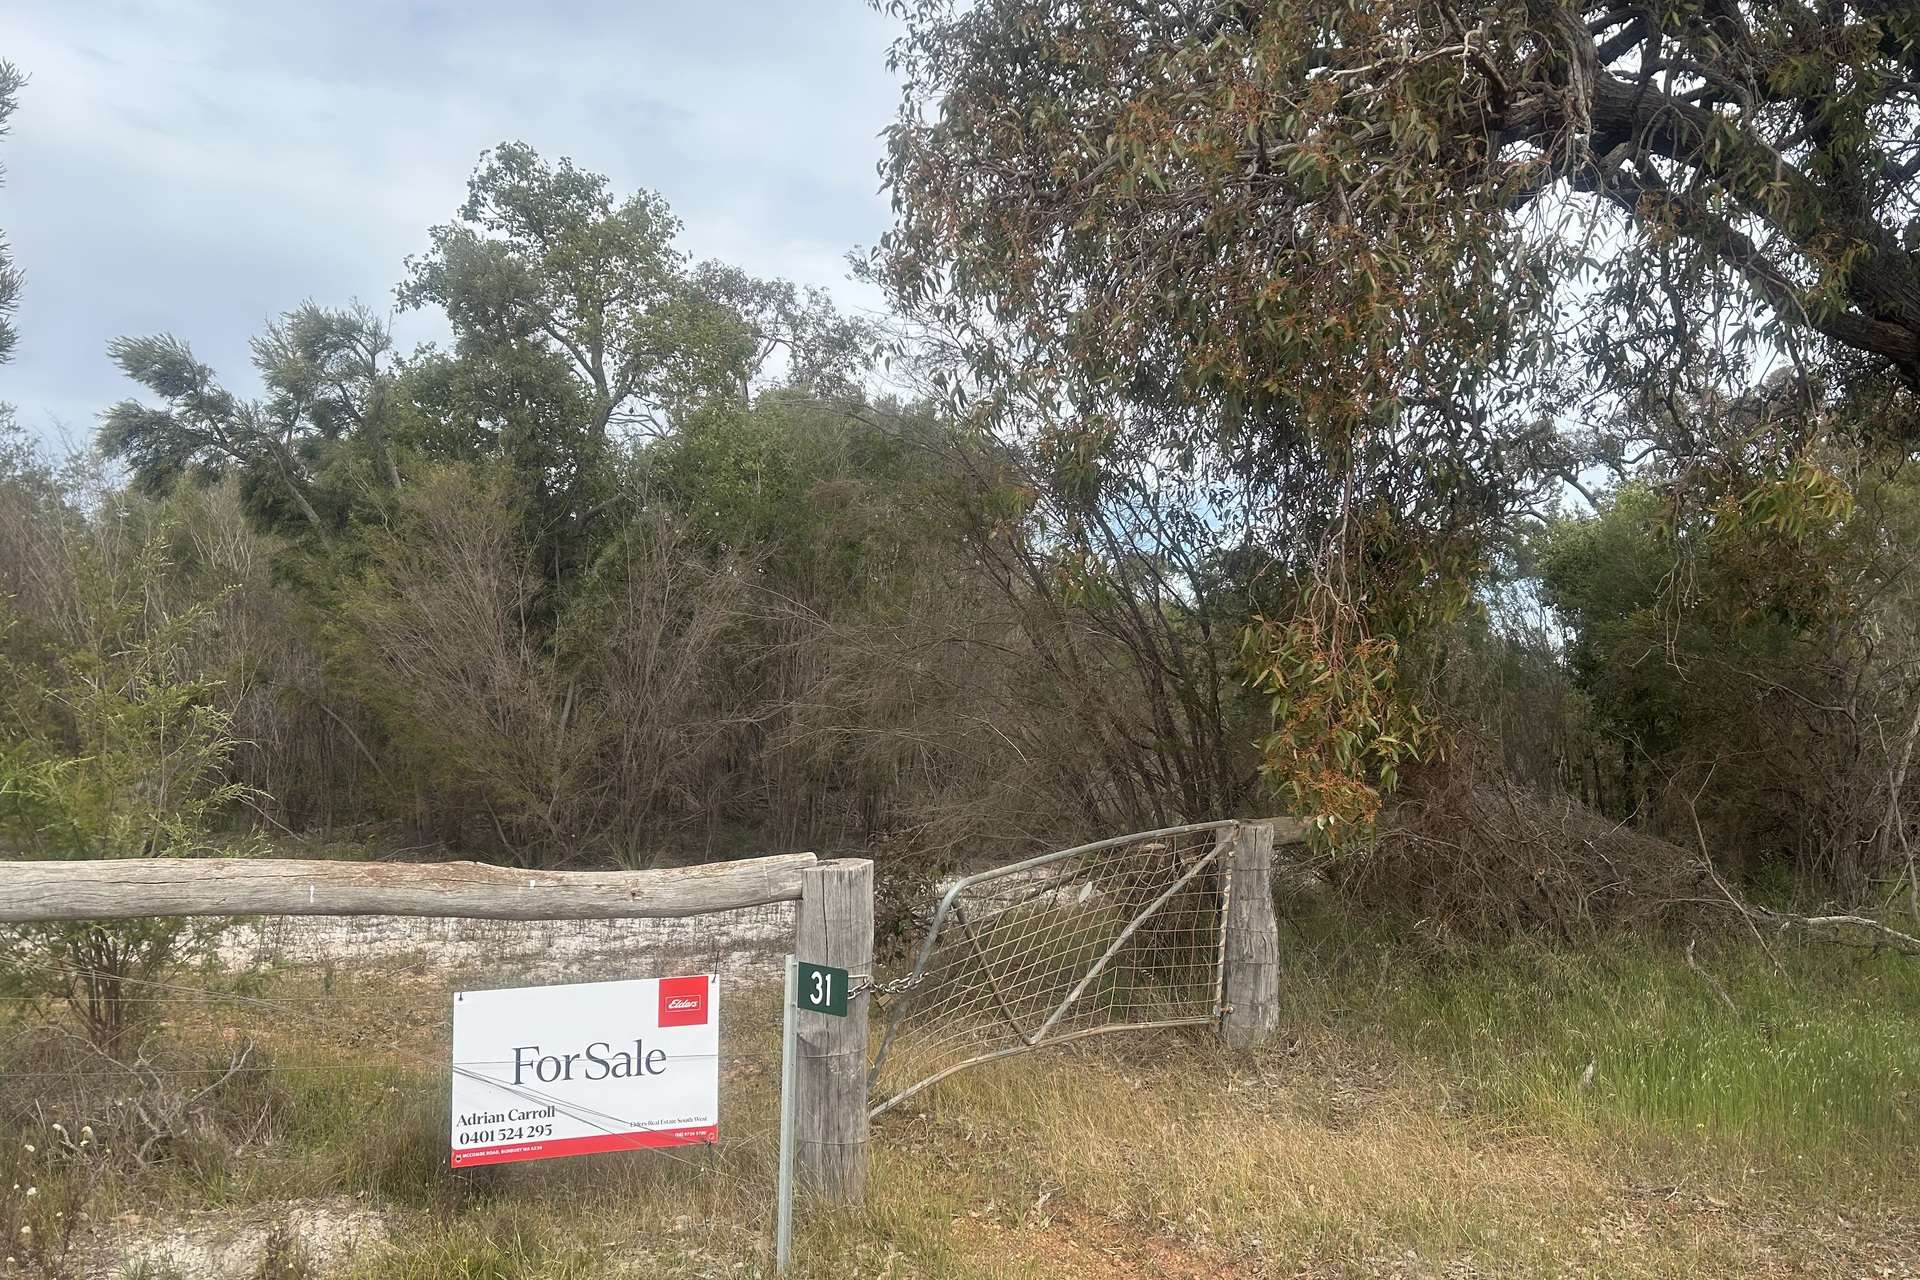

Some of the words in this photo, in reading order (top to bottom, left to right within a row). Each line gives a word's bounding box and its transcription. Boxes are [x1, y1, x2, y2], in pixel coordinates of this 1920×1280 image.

[810, 971, 831, 1006] 31
[668, 998, 698, 1009] Elders
[512, 1046, 580, 1085] For
[585, 1039, 667, 1080] Sale
[456, 1112, 505, 1127] Adrian
[508, 1105, 555, 1121] Carroll
[460, 1130, 495, 1145] 0401
[498, 1126, 523, 1141] 524
[526, 1124, 553, 1138] 295
